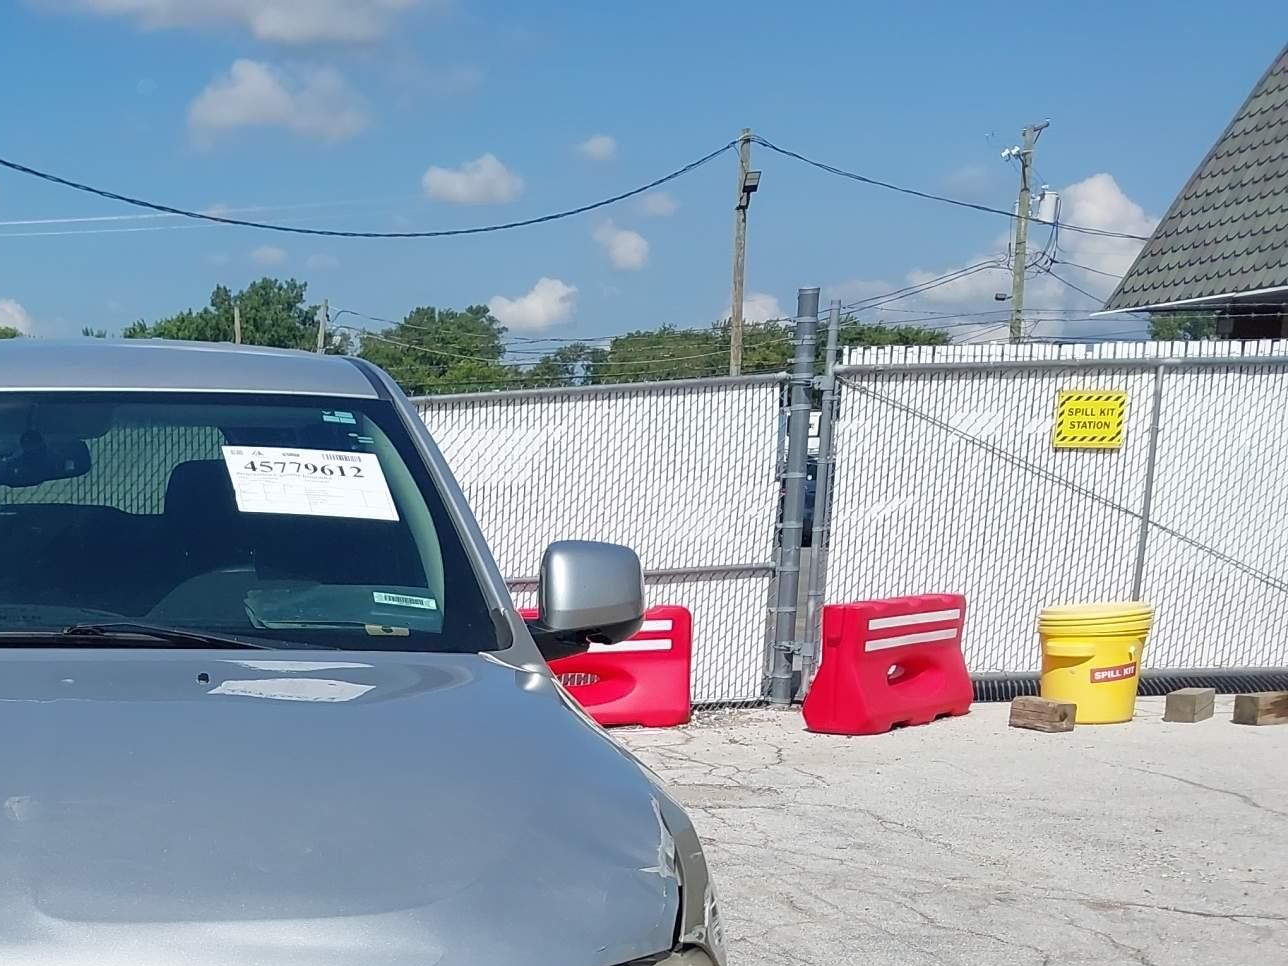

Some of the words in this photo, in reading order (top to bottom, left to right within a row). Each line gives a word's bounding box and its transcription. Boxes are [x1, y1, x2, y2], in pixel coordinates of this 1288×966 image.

[1067, 407, 1096, 417] SPILL
[1099, 407, 1116, 417] KIT
[1068, 420, 1111, 430] STATION
[244, 460, 365, 478] 45779612
[1094, 670, 1122, 680] SPILL
[1123, 666, 1135, 676] KIT
